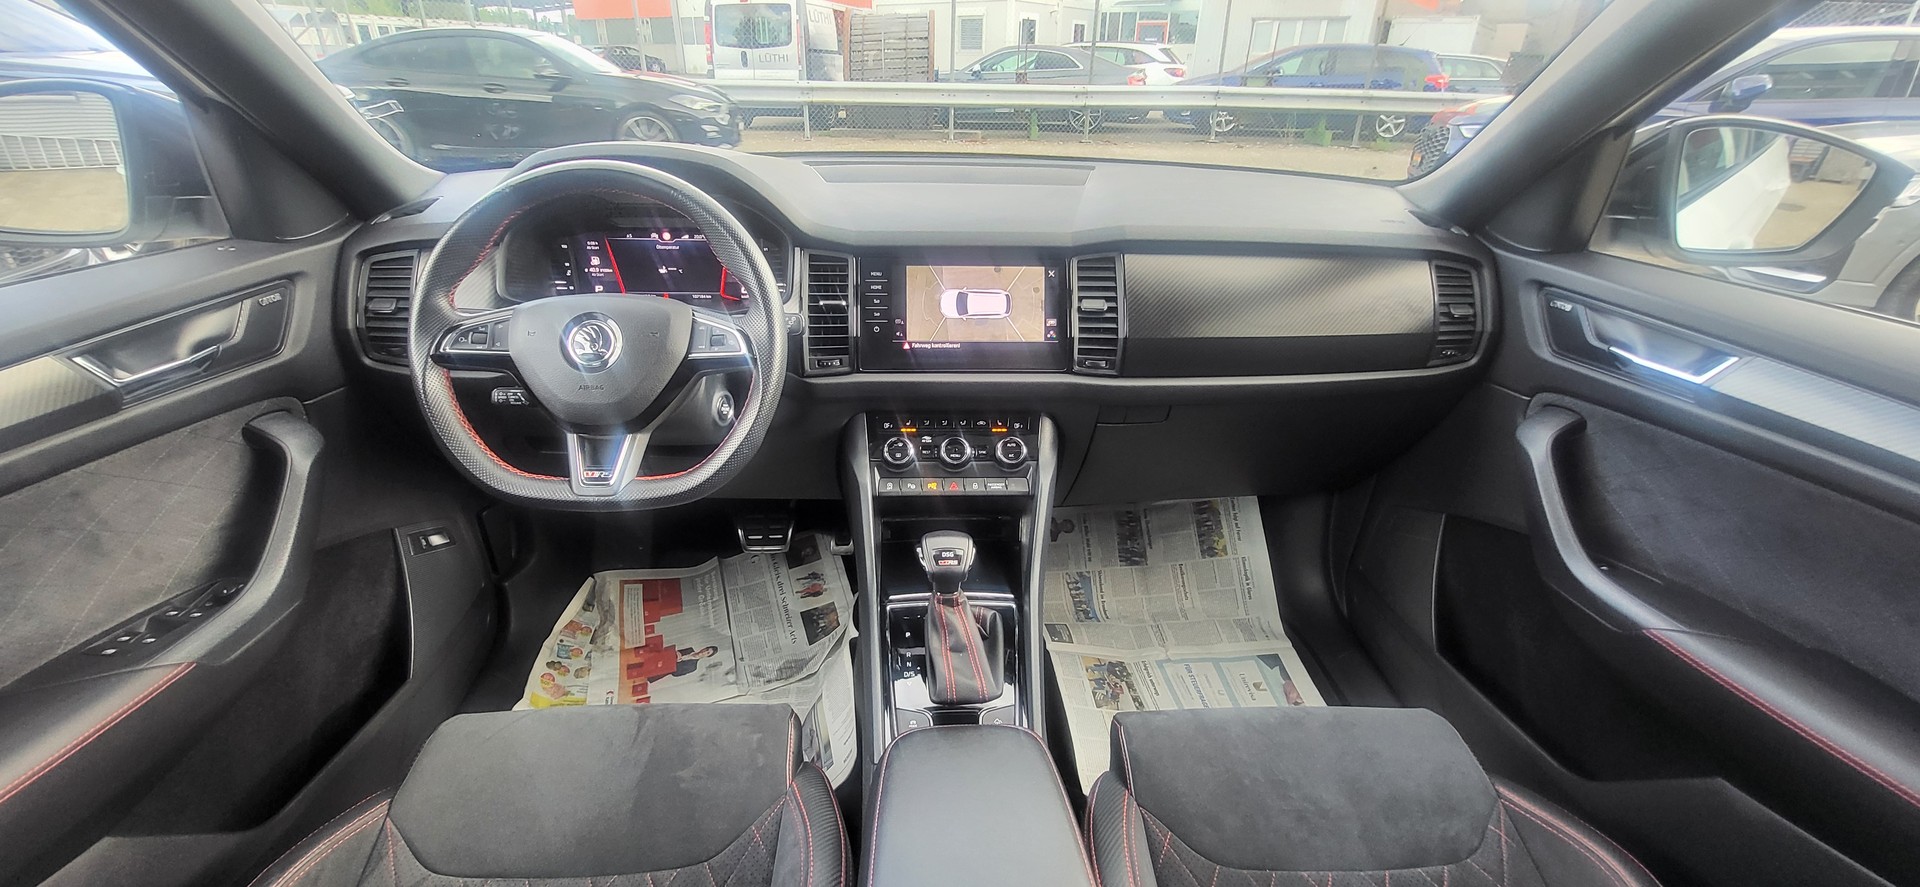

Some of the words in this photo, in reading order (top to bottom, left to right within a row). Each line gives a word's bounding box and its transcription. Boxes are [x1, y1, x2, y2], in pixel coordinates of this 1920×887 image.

[808, 9, 832, 25] LÜTHI
[758, 52, 789, 63] LÜTHI
[594, 285, 603, 293] P
[781, 595, 794, 628] Schweizer
[789, 629, 798, 645] Acts
[1183, 663, 1193, 674] FÜR
